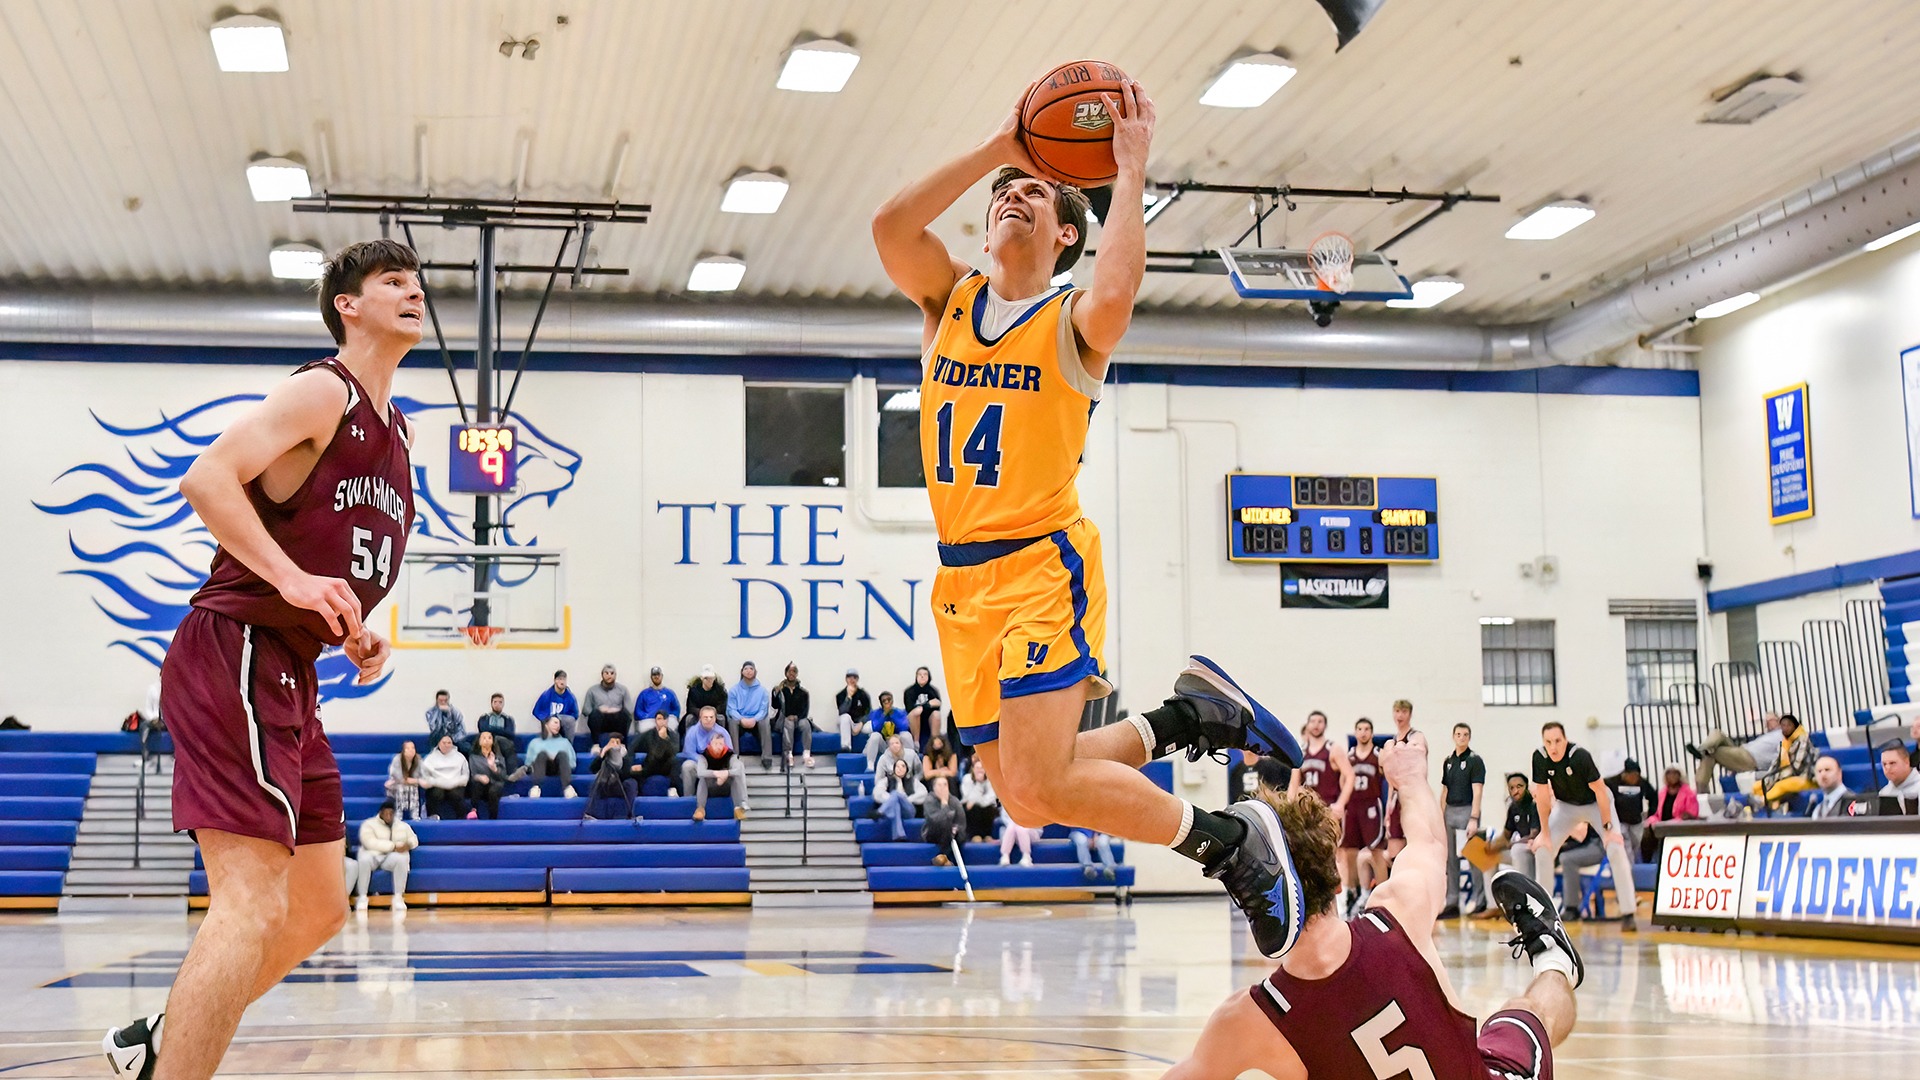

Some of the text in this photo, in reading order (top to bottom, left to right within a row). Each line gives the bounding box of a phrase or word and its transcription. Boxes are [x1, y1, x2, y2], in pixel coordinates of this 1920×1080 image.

[480, 450, 504, 486] 9
[936, 400, 1005, 488] 14
[350, 526, 393, 588] 54
[657, 500, 845, 566] THE
[731, 577, 923, 641] DEN
[1667, 842, 1737, 880] Office
[1756, 841, 1920, 919] WIDENE
[1669, 886, 1732, 912] DEPOT
[1350, 999, 1436, 1080] 5
